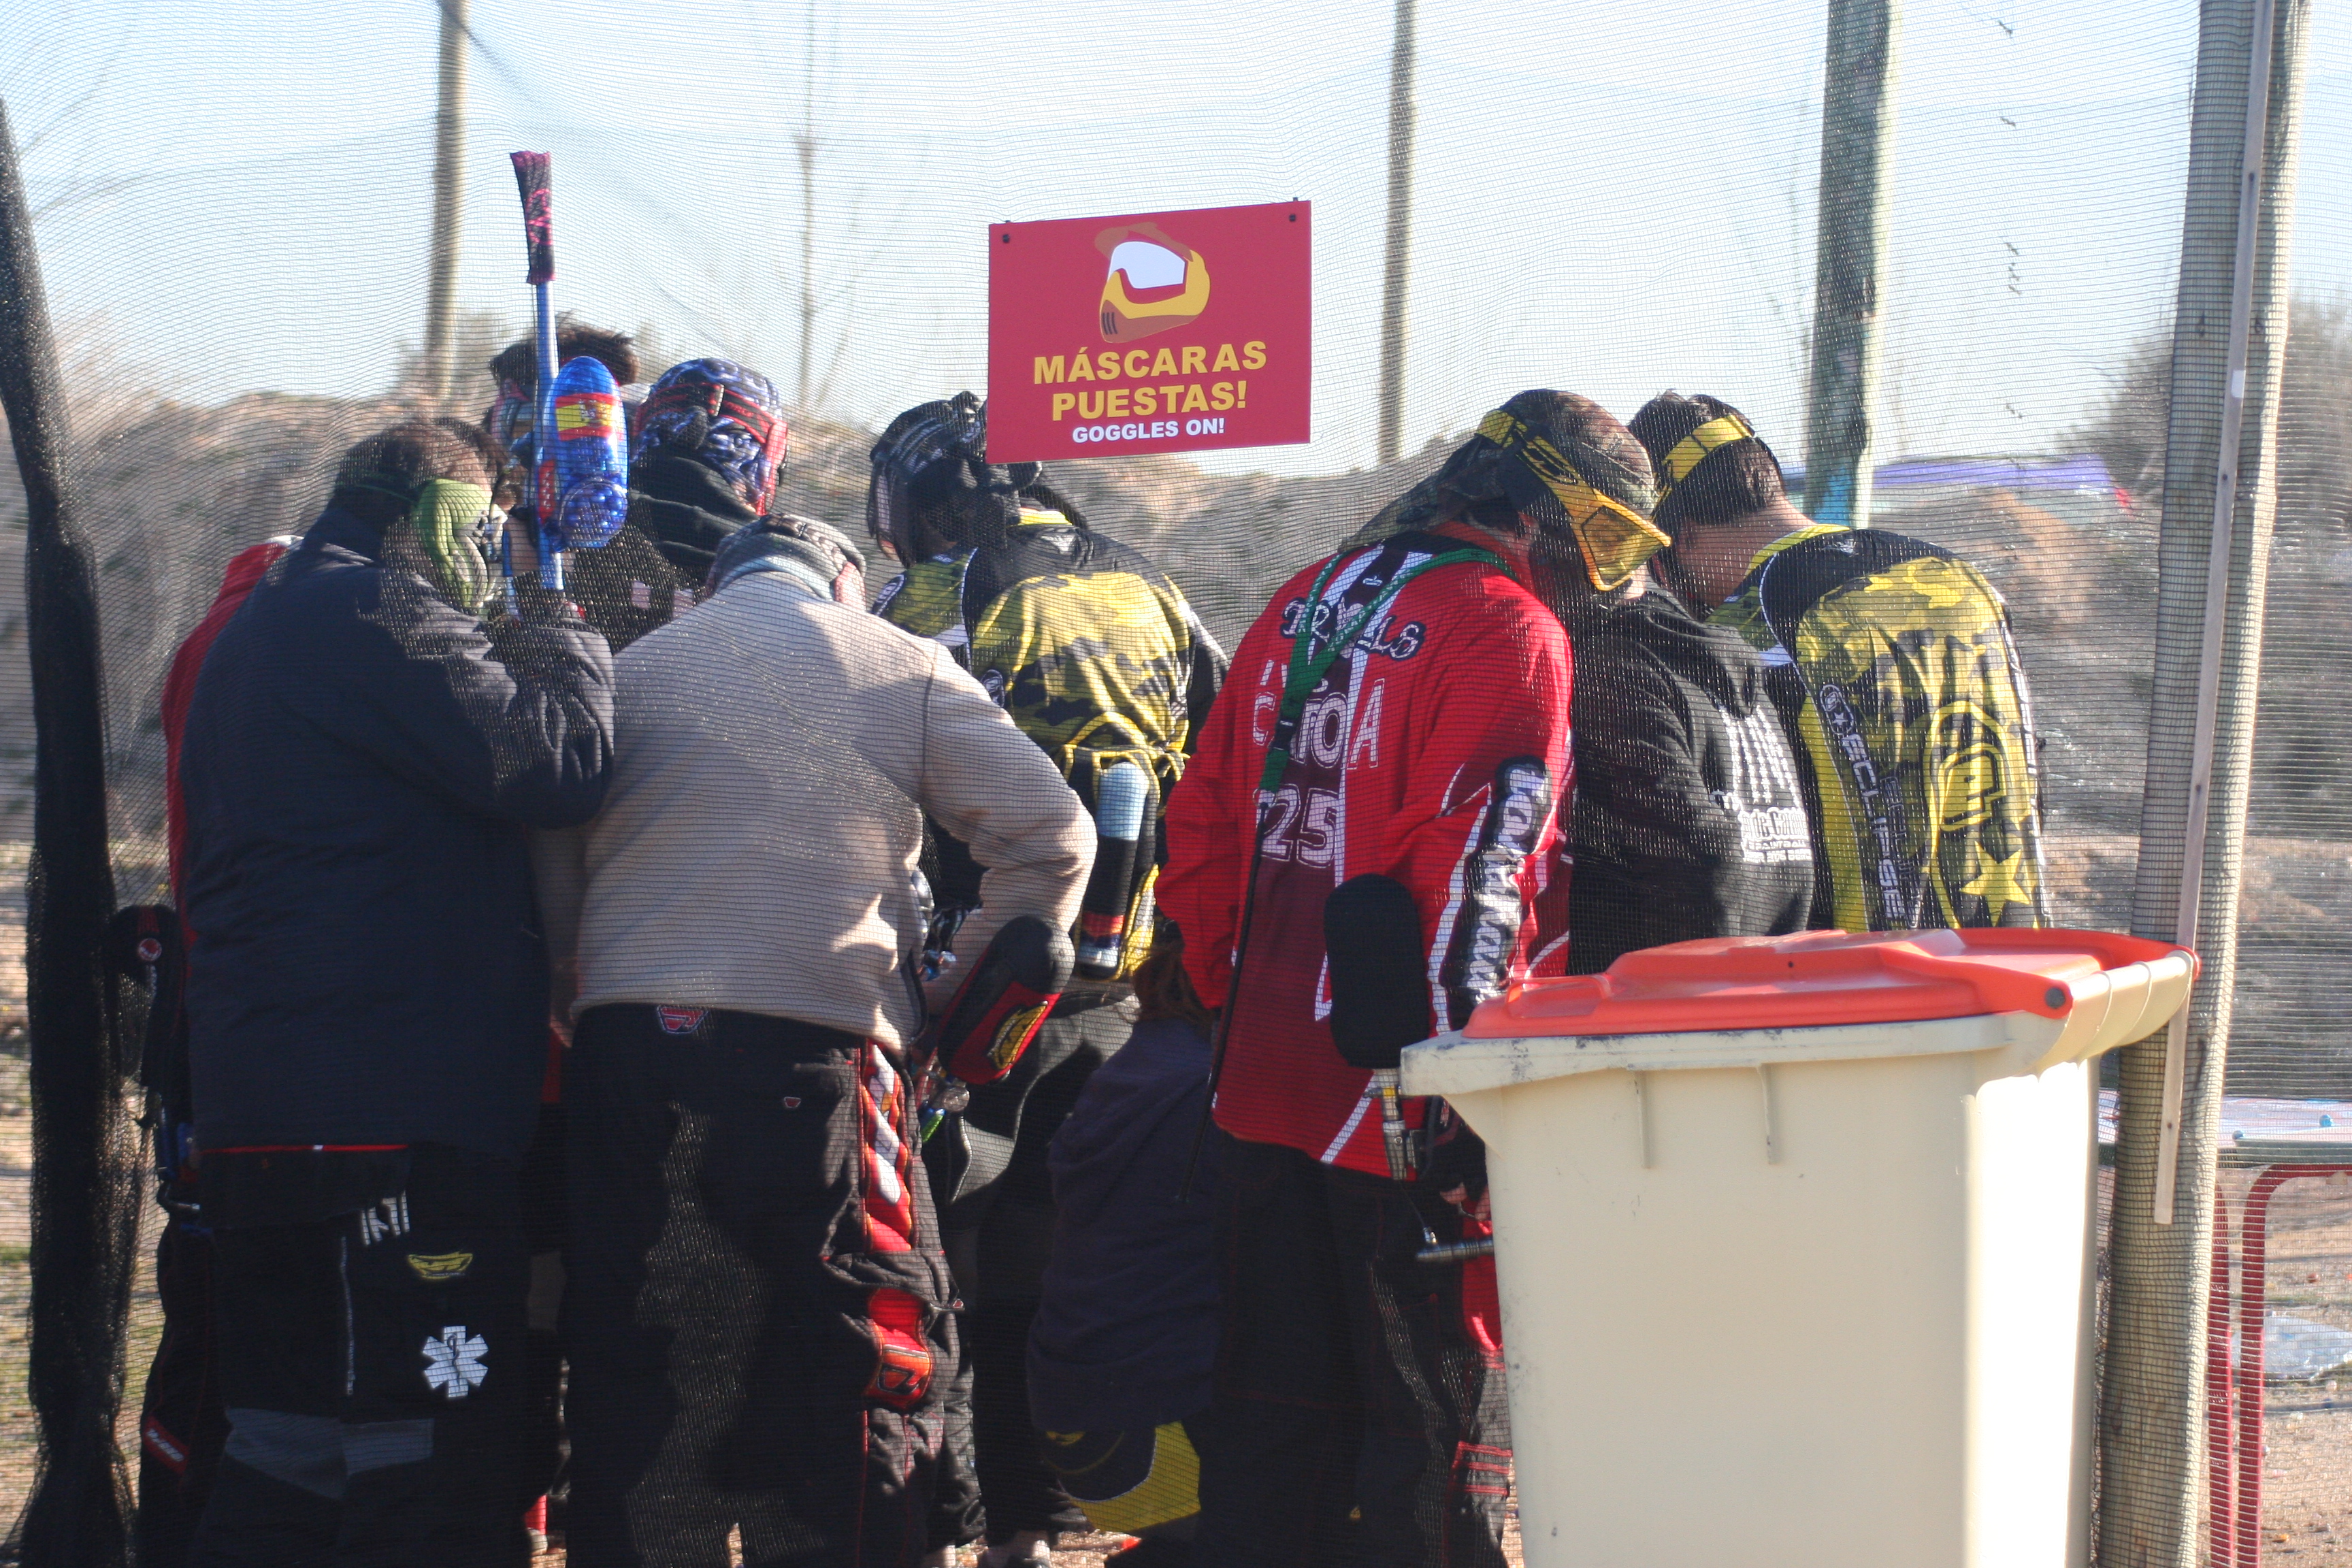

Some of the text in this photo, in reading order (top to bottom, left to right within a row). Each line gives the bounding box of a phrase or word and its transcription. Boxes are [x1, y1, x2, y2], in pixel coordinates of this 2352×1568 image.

[1033, 340, 1267, 385] MÁSCARAS
[1051, 380, 1247, 421] PUESTAS!
[1072, 418, 1225, 444] GOGGLES ON!
[1253, 784, 1339, 867] 25
